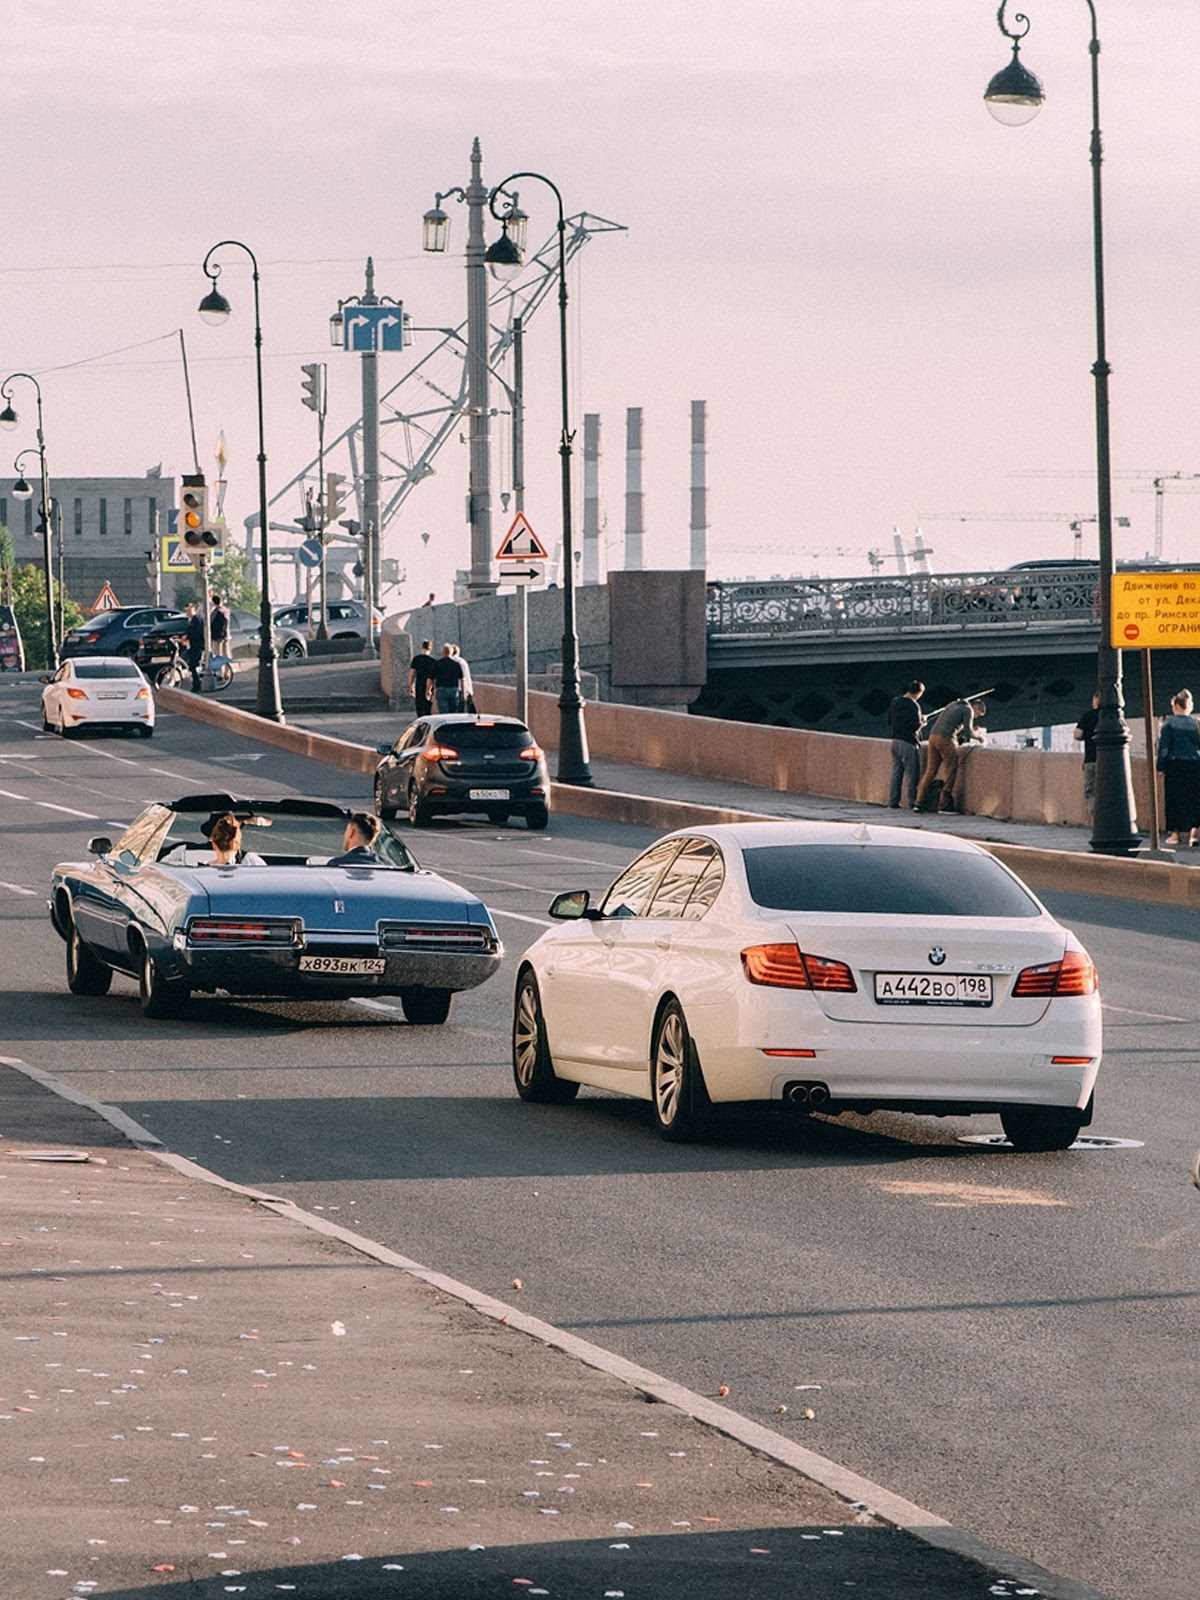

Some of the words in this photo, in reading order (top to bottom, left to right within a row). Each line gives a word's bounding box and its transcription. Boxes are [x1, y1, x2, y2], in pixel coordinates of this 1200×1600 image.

[1123, 581, 1178, 591] Движение
[1117, 612, 1129, 620] до
[1135, 612, 1150, 621] пр.
[304, 958, 358, 972] Х893ВК
[362, 959, 381, 970] 124
[960, 978, 987, 992] 198
